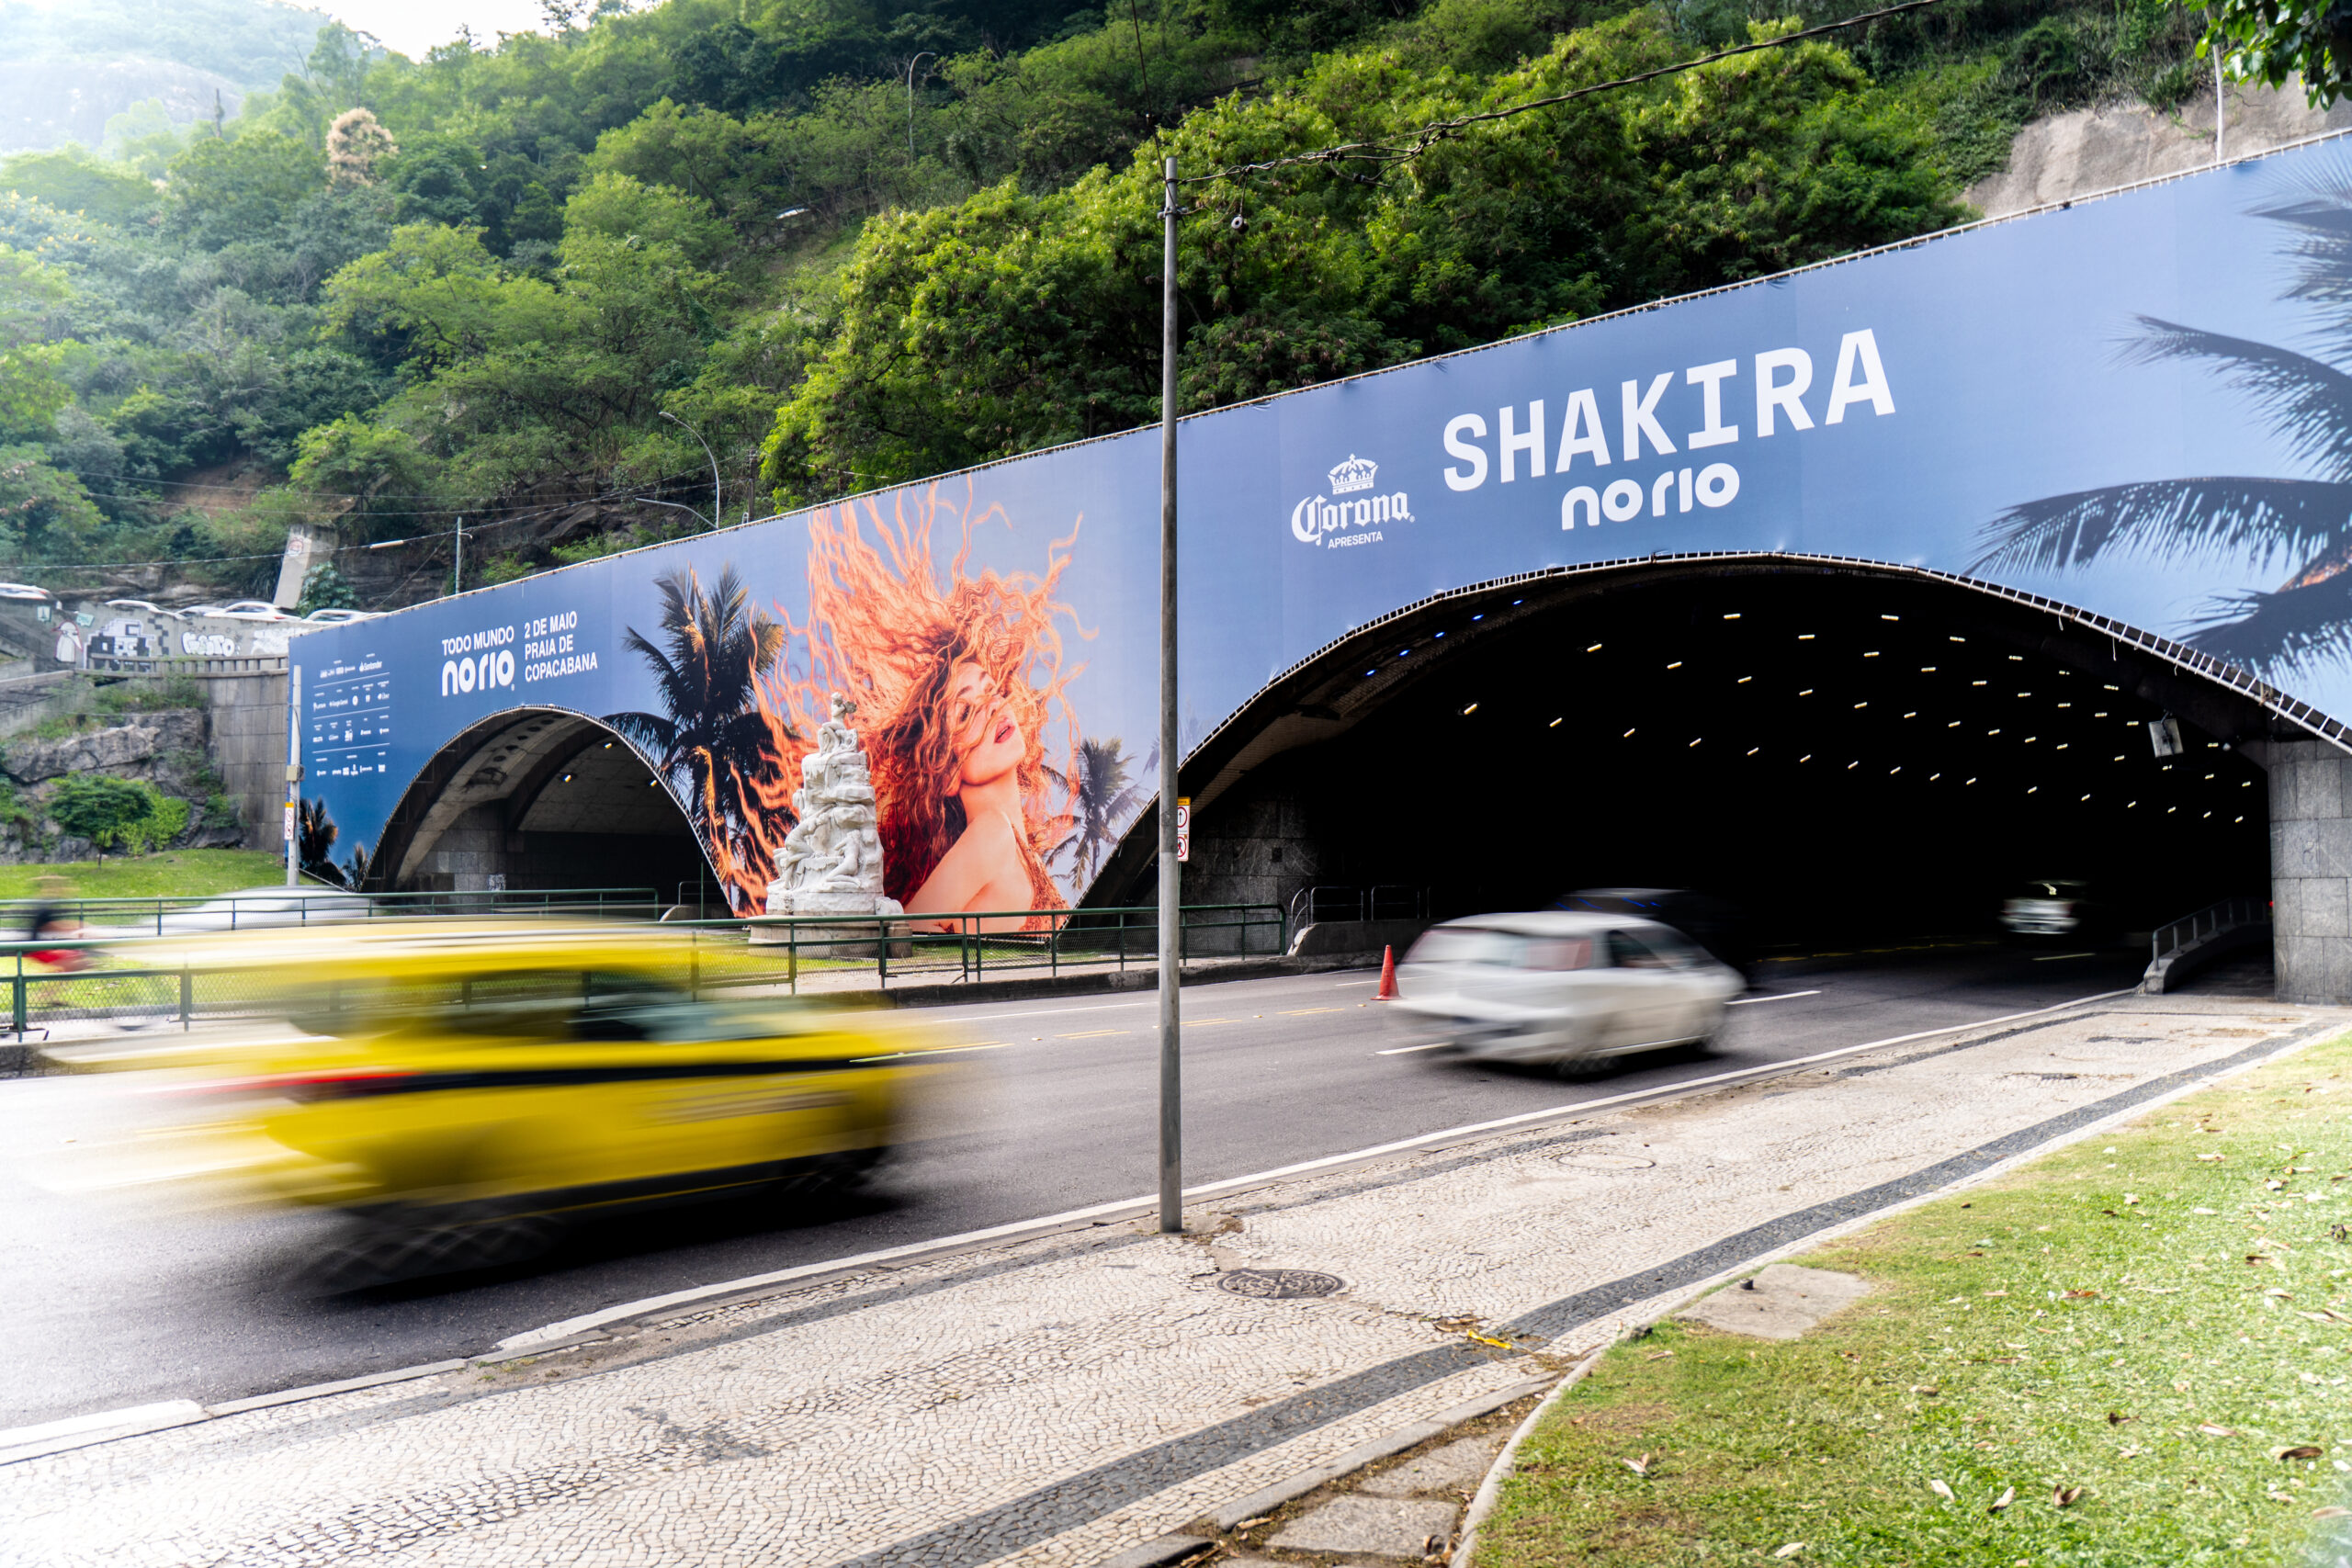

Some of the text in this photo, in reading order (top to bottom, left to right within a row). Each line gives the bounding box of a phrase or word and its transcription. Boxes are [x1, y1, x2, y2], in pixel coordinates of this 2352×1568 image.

[1442, 328, 1896, 491] SHAKIRA
[1291, 491, 1411, 546] Corona
[1328, 531, 1383, 549] APRESENTA
[524, 611, 577, 638] 2 DE MAIO
[442, 626, 514, 656] TODO MUNDO
[525, 634, 573, 660] PRAIA DE
[525, 652, 598, 682] COPACABANA
